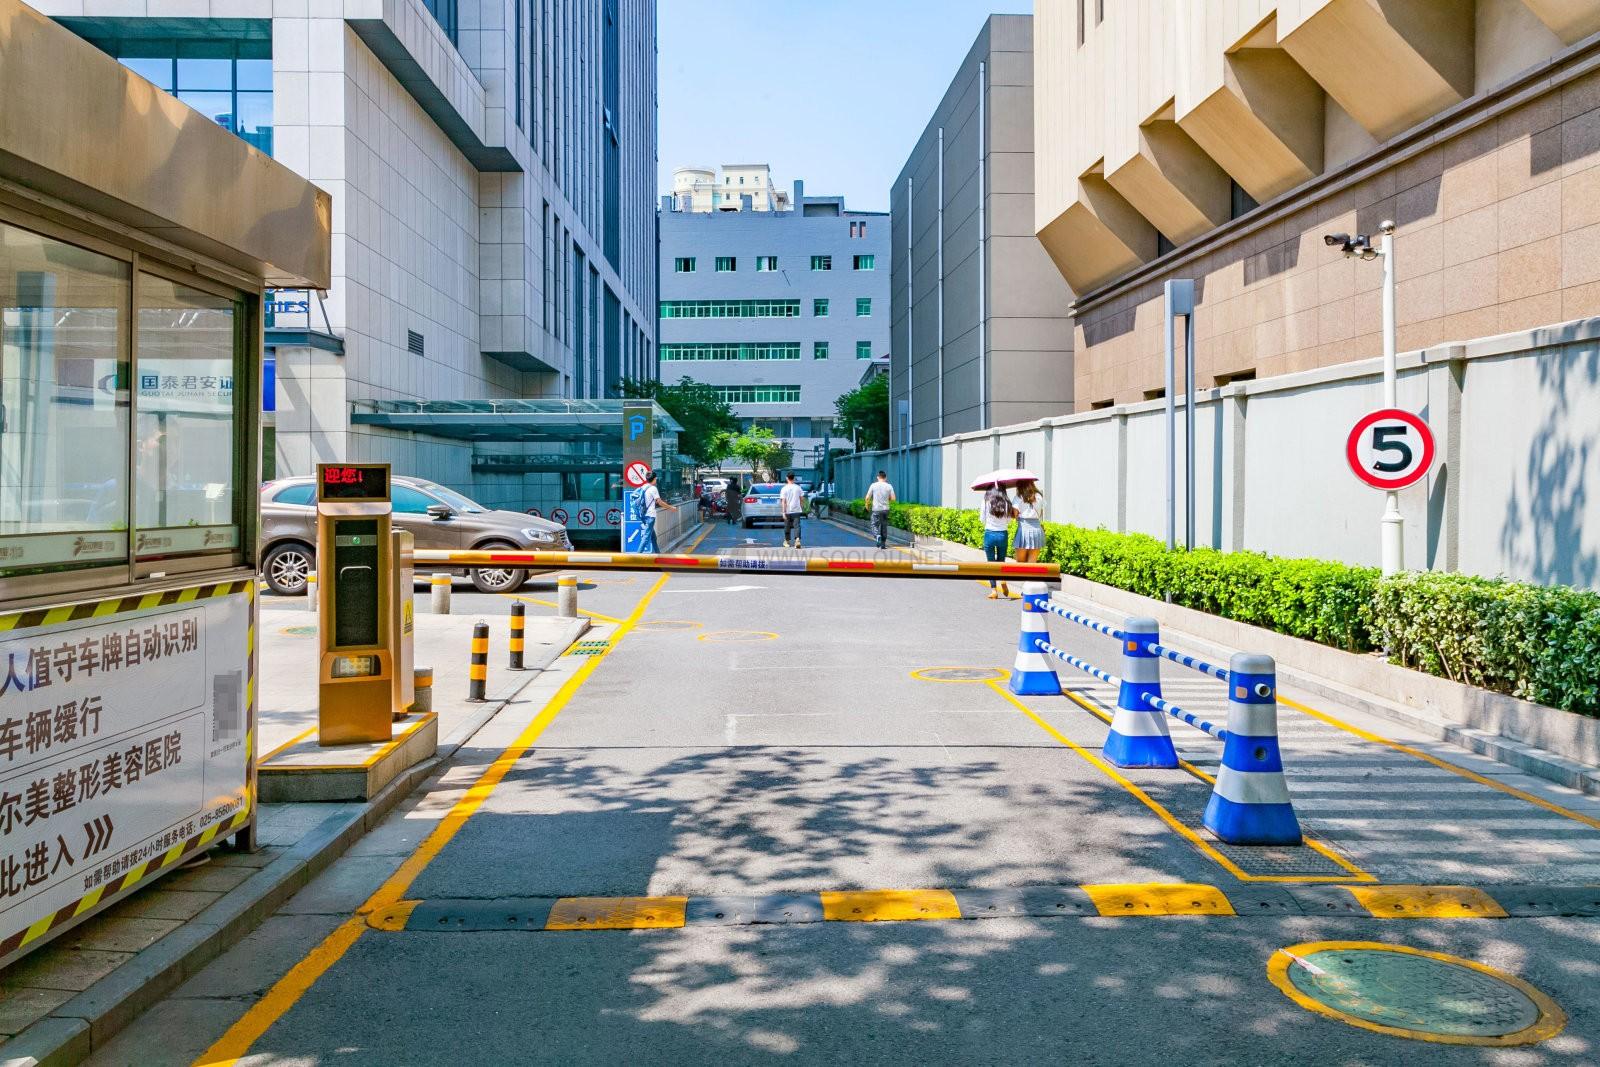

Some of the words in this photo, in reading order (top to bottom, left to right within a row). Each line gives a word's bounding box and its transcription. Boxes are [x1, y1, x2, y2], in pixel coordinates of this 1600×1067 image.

[1373, 425, 1412, 473] 5
[582, 511, 590, 523] 5
[0, 616, 198, 697] 人值守车牌自动识别
[0, 696, 103, 761] 车辆缓行
[0, 730, 182, 836] 尔美整形美容医院
